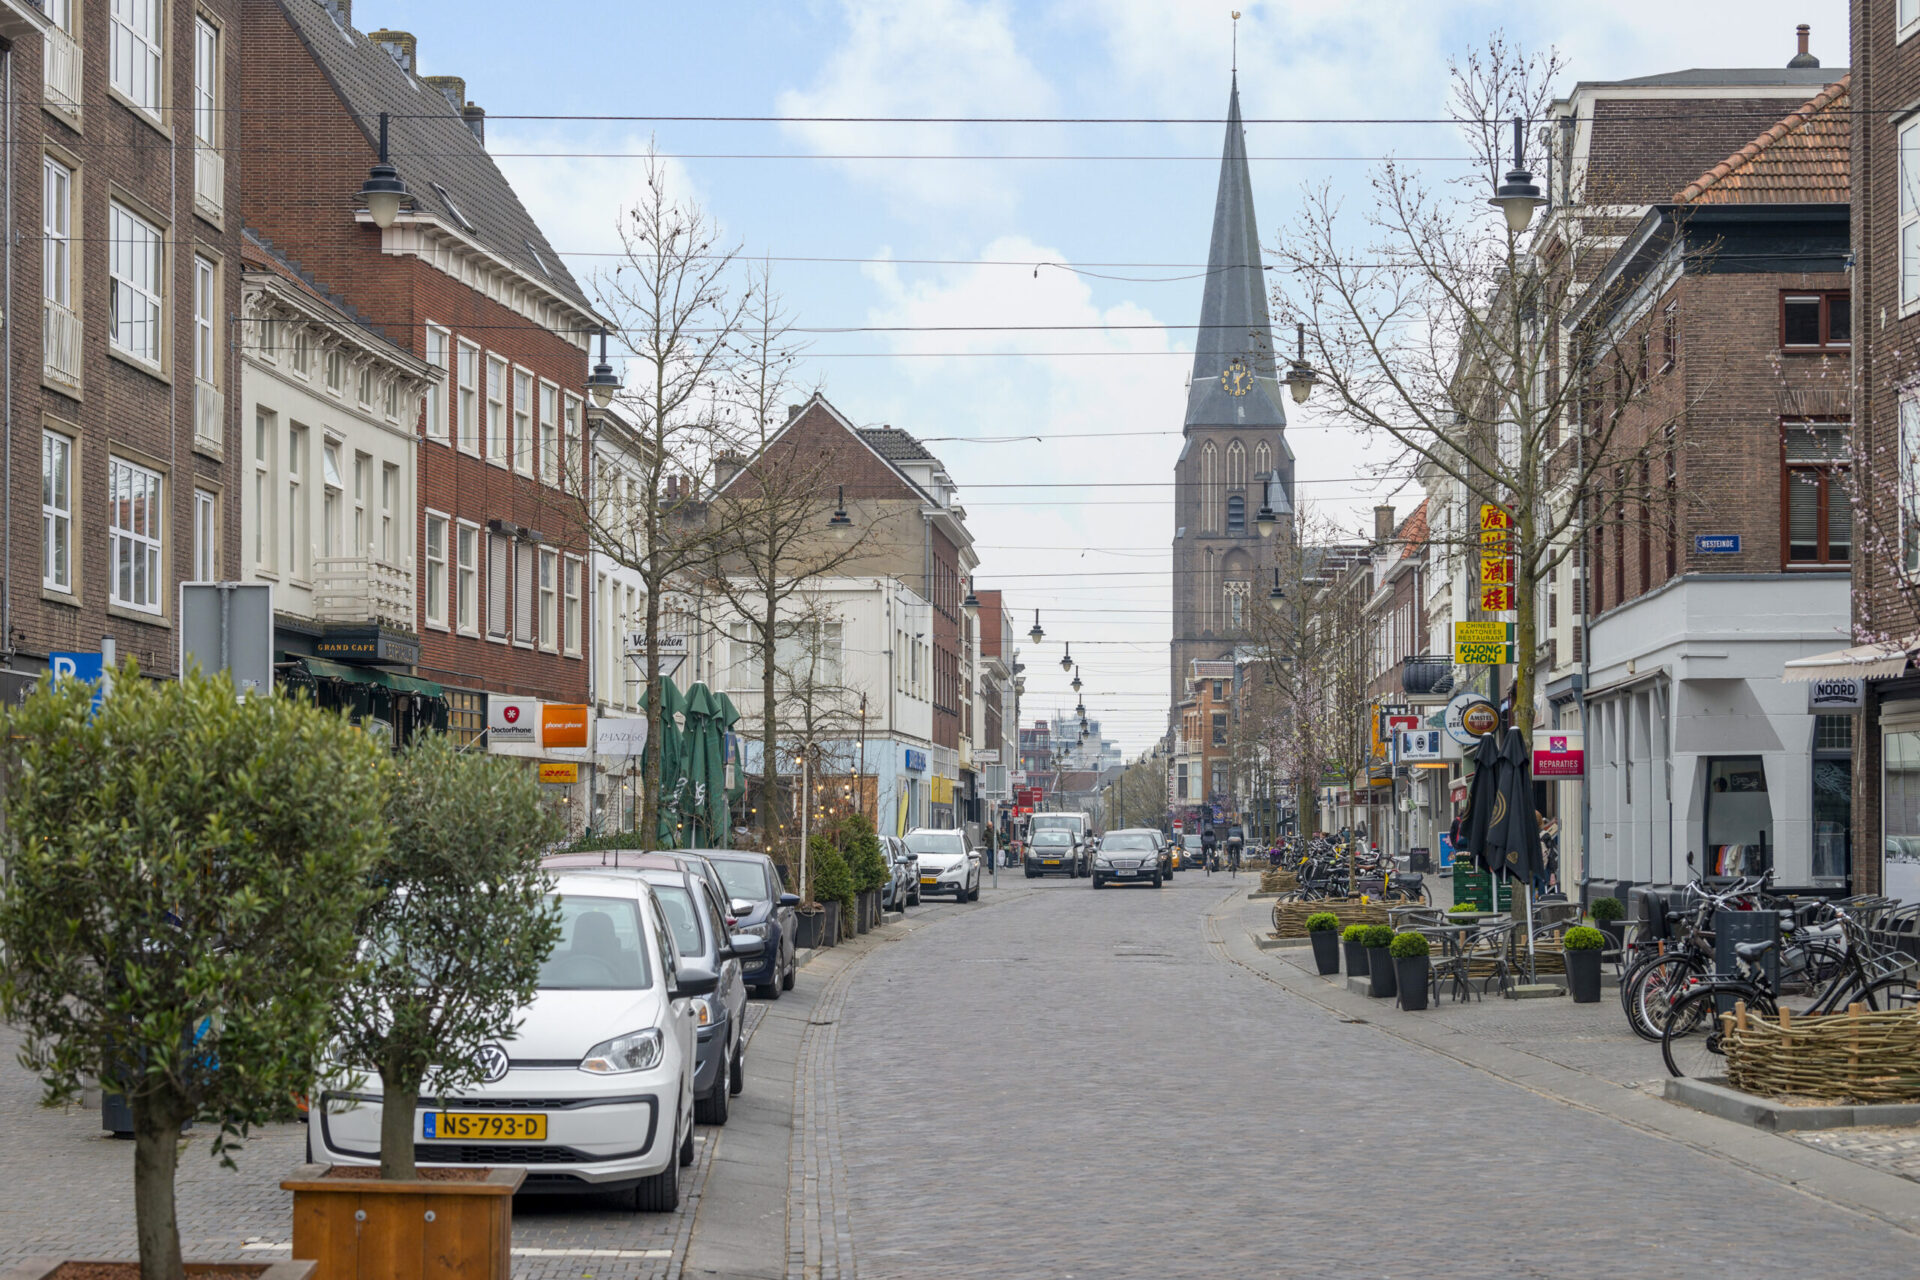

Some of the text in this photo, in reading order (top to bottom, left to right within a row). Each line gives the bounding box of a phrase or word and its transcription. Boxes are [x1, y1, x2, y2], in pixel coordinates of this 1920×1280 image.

[1701, 539, 1734, 548] WESTEINDE
[632, 634, 683, 648] Veluizen
[317, 643, 376, 652] GRAND CAFE
[1459, 644, 1502, 655] KWONG
[1463, 653, 1498, 664] CHOW
[1817, 684, 1856, 696] NOORD
[491, 726, 532, 734] DoctorPhone
[1539, 760, 1578, 768] REPARATIES
[443, 1116, 538, 1136] NS-793-D
